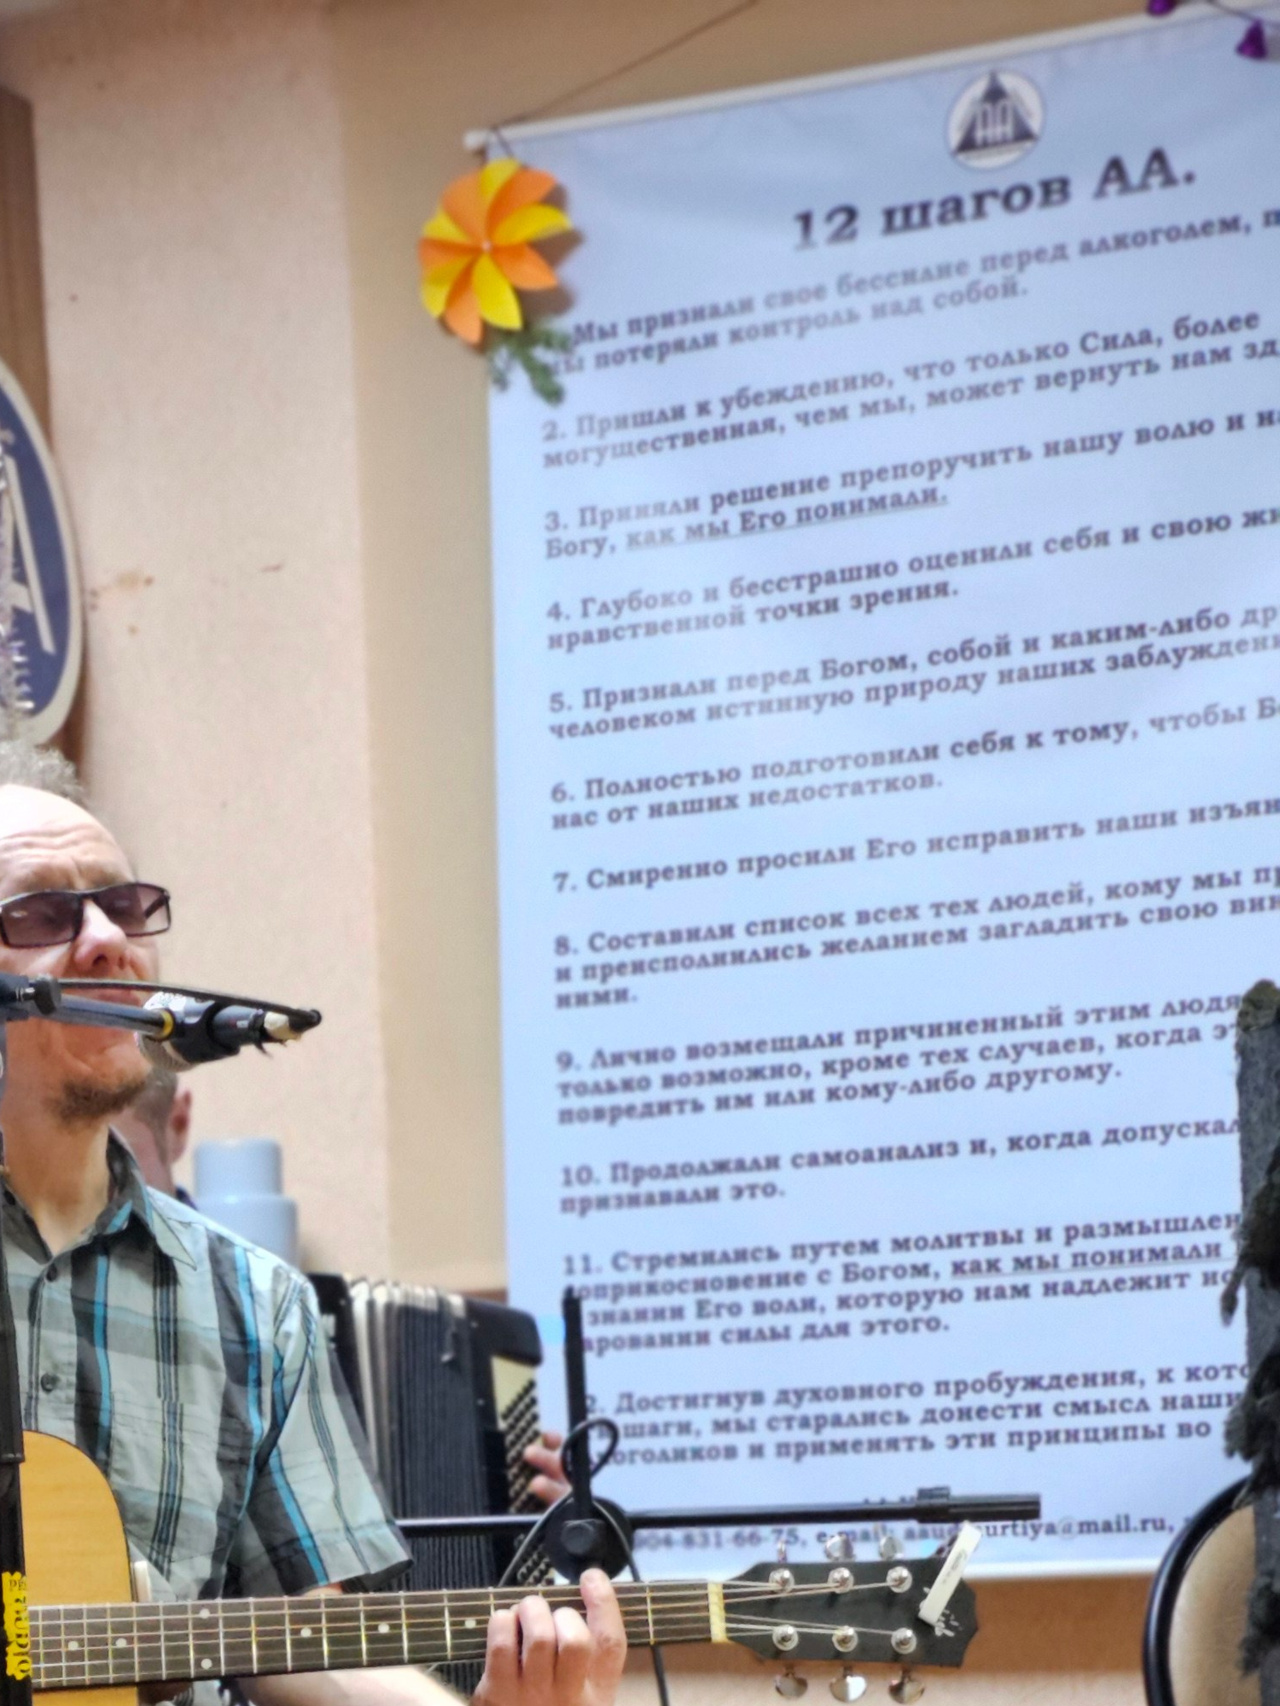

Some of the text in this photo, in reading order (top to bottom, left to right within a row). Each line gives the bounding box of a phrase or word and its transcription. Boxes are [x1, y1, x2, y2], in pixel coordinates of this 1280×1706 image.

[794, 147, 1196, 250] 12 шагов АА.
[626, 297, 755, 339] признали
[980, 242, 1070, 280] перед
[1078, 215, 1252, 256] алкоголем,
[543, 346, 1232, 467] могущественная, чем мы, может вернуть нам
[576, 404, 687, 438] Пришли
[719, 372, 895, 419] убеждению,
[902, 359, 957, 381] что
[964, 341, 1070, 372] только
[1078, 328, 1164, 354] Сила,
[1172, 312, 1260, 341] более
[577, 496, 700, 531] Приняли
[709, 475, 830, 515] решение
[840, 445, 1033, 492] препоручить
[1042, 431, 1124, 458] нашу
[1134, 418, 1215, 445] волю
[545, 524, 617, 559] Богу,
[738, 510, 787, 534] Его
[795, 487, 948, 526] понимали.
[580, 589, 693, 620] Глубоко
[728, 560, 900, 598] бесстрашно
[907, 541, 1033, 573] оценили
[1042, 526, 1111, 554] себя
[1150, 514, 1232, 540] свою
[755, 597, 840, 623] точки
[849, 581, 959, 615] зрения.
[582, 678, 717, 712] Признали
[726, 667, 811, 694] перед
[820, 654, 918, 680] Богом,
[926, 633, 1012, 666] собой
[1050, 607, 1231, 649] каким-либо
[548, 708, 696, 739] человеком
[864, 672, 988, 706] природу
[997, 657, 1097, 685] наших
[585, 767, 742, 800] Полностью
[751, 744, 940, 780] подготовили
[949, 730, 1016, 758] себя
[1052, 722, 1138, 745] тому,
[1148, 702, 1246, 733] чтобы
[551, 811, 599, 830] нас
[647, 795, 740, 819] наших
[748, 772, 943, 807] недостатков.
[586, 810, 1178, 889] Смиренно просили Его исправить наши
[581, 943, 812, 985] преисполнились
[820, 927, 968, 956] желанием
[979, 911, 1130, 941] загладить
[1138, 901, 1219, 925] свою
[587, 924, 736, 953] Составили
[744, 912, 846, 937] список
[855, 904, 921, 926] всех
[929, 899, 980, 918] тех
[987, 882, 1094, 913] людей,
[1105, 877, 1182, 900] кому
[555, 988, 637, 1009] ними.
[556, 1027, 1203, 1098] только возможно, кроме тех случаев, когда
[590, 1003, 1151, 1069] Лично возмещали причиненный этим
[557, 1098, 706, 1127] повредить
[764, 1088, 816, 1107] или
[825, 1069, 977, 1103] кому-либо
[984, 1062, 1122, 1093] другому.
[561, 1164, 601, 1188] 10.
[609, 1155, 781, 1188] Продолжали
[790, 1141, 960, 1169] самоанализ
[1006, 1130, 1093, 1152] когда
[559, 1182, 785, 1218] признавали это.
[564, 1254, 602, 1276] 11.
[610, 1246, 781, 1275] Стремились
[790, 1239, 880, 1266] путем
[890, 1229, 1024, 1253] молитвы
[842, 1260, 941, 1285] Богом,
[950, 1258, 1003, 1277] как
[1070, 1243, 1222, 1269] понимали
[587, 1272, 1191, 1326] знании Его воли, которую нам надлежит
[719, 1316, 950, 1344] силы для этого.
[614, 1390, 766, 1415] Достигнув
[773, 1382, 925, 1409] духовного
[933, 1370, 1146, 1401] пробуждения,
[622, 1421, 702, 1439] шаги,
[765, 1410, 911, 1435] старались
[919, 1403, 1043, 1425] донести
[1052, 1398, 1151, 1417] смысл
[774, 1435, 936, 1463] применять
[945, 1432, 997, 1450] эти
[1007, 1423, 1166, 1452] принципы
[905, 1514, 1175, 1541] aaudurtiya@mail.ru,
